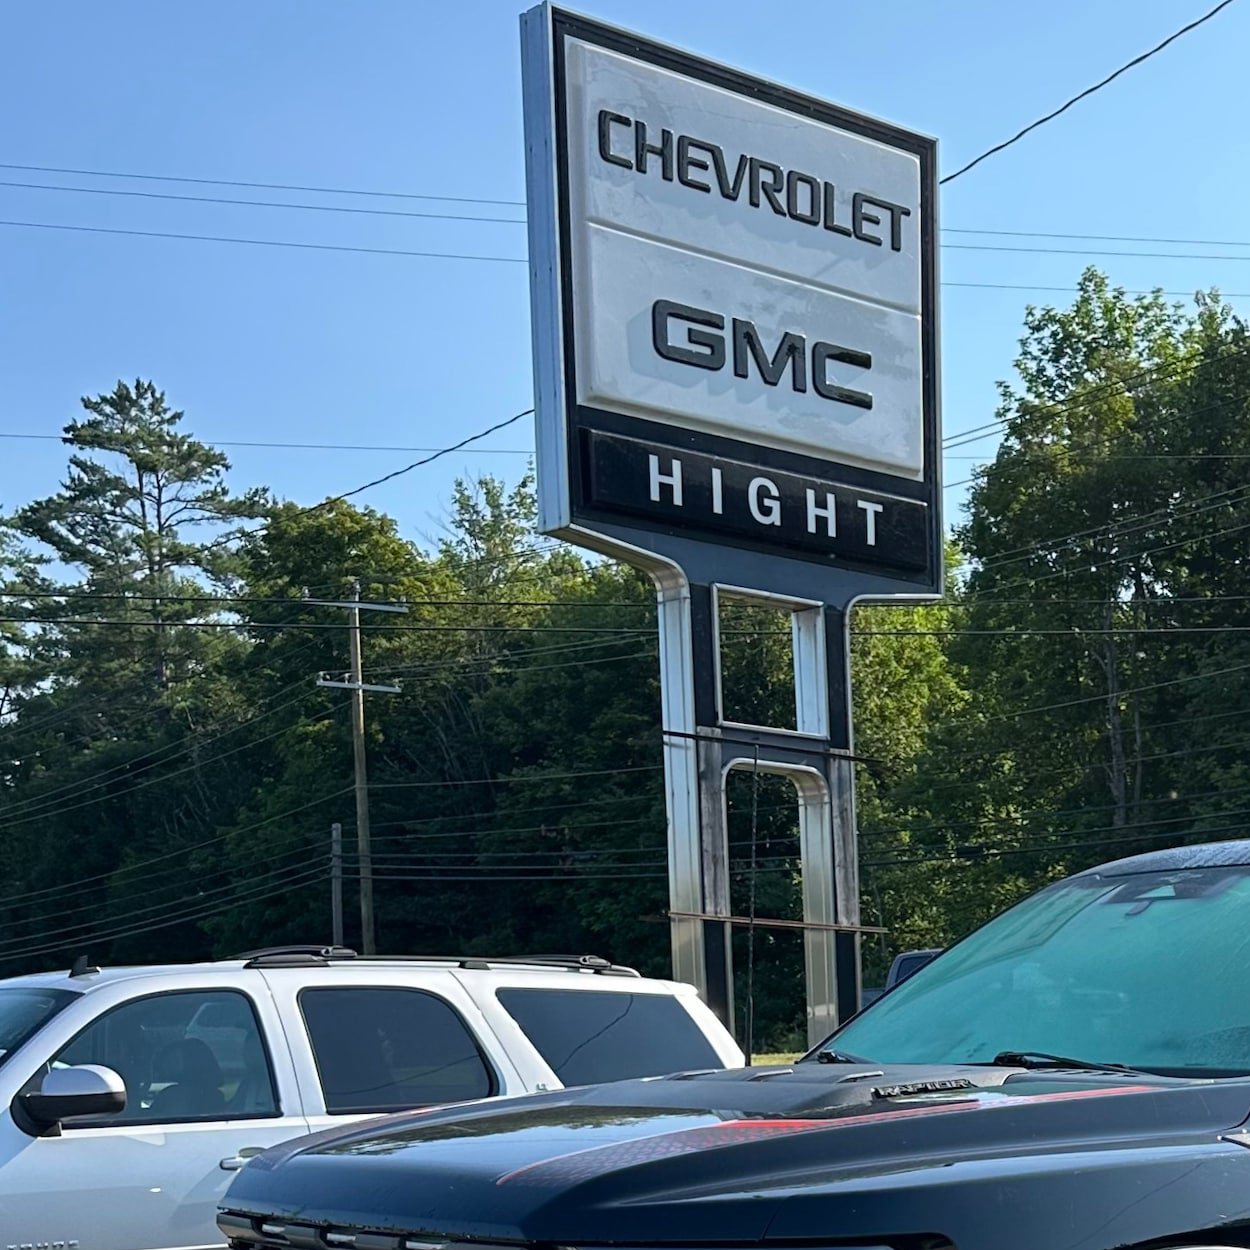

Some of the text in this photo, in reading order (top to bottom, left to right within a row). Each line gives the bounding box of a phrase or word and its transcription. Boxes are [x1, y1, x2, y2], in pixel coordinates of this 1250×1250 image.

[598, 109, 911, 252] CHEVROLET
[652, 299, 873, 409] GMC
[648, 454, 884, 546] HIGHT
[877, 1079, 973, 1097] RAPTOR
